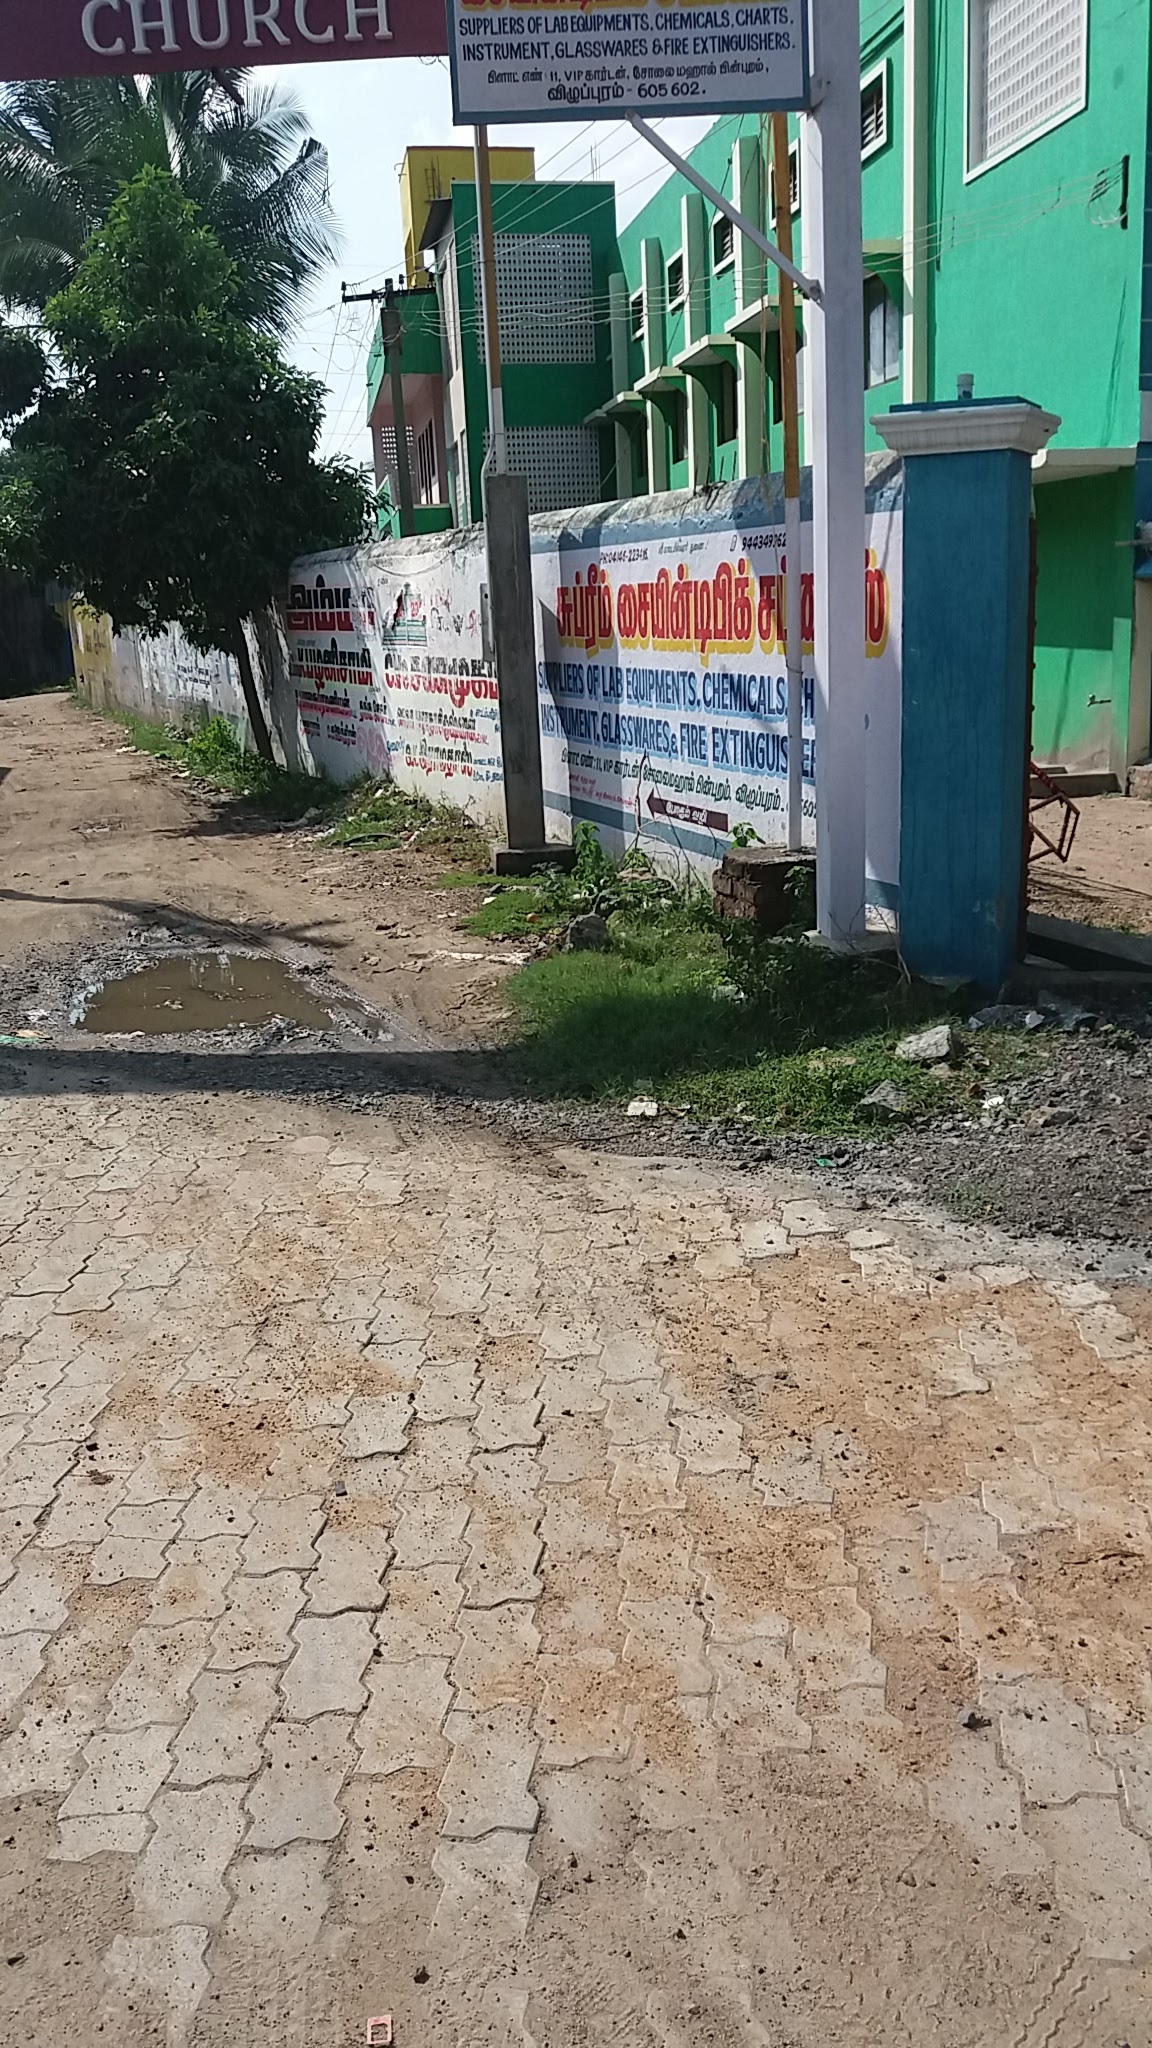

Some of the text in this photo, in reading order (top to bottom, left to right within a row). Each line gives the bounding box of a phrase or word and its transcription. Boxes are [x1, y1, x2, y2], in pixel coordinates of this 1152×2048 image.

[81, 0, 393, 56] CHURCH
[459, 16, 525, 36] SUPPLIERS
[527, 16, 543, 34] OF
[544, 15, 568, 33] LAB
[547, 81, 624, 104] விழுப்புரம்
[637, 83, 667, 98] 605
[538, 661, 584, 695] SUPPLIERS
[587, 664, 599, 692] OF
[602, 666, 623, 698] LAB
[680, 723, 707, 760] FIRE
